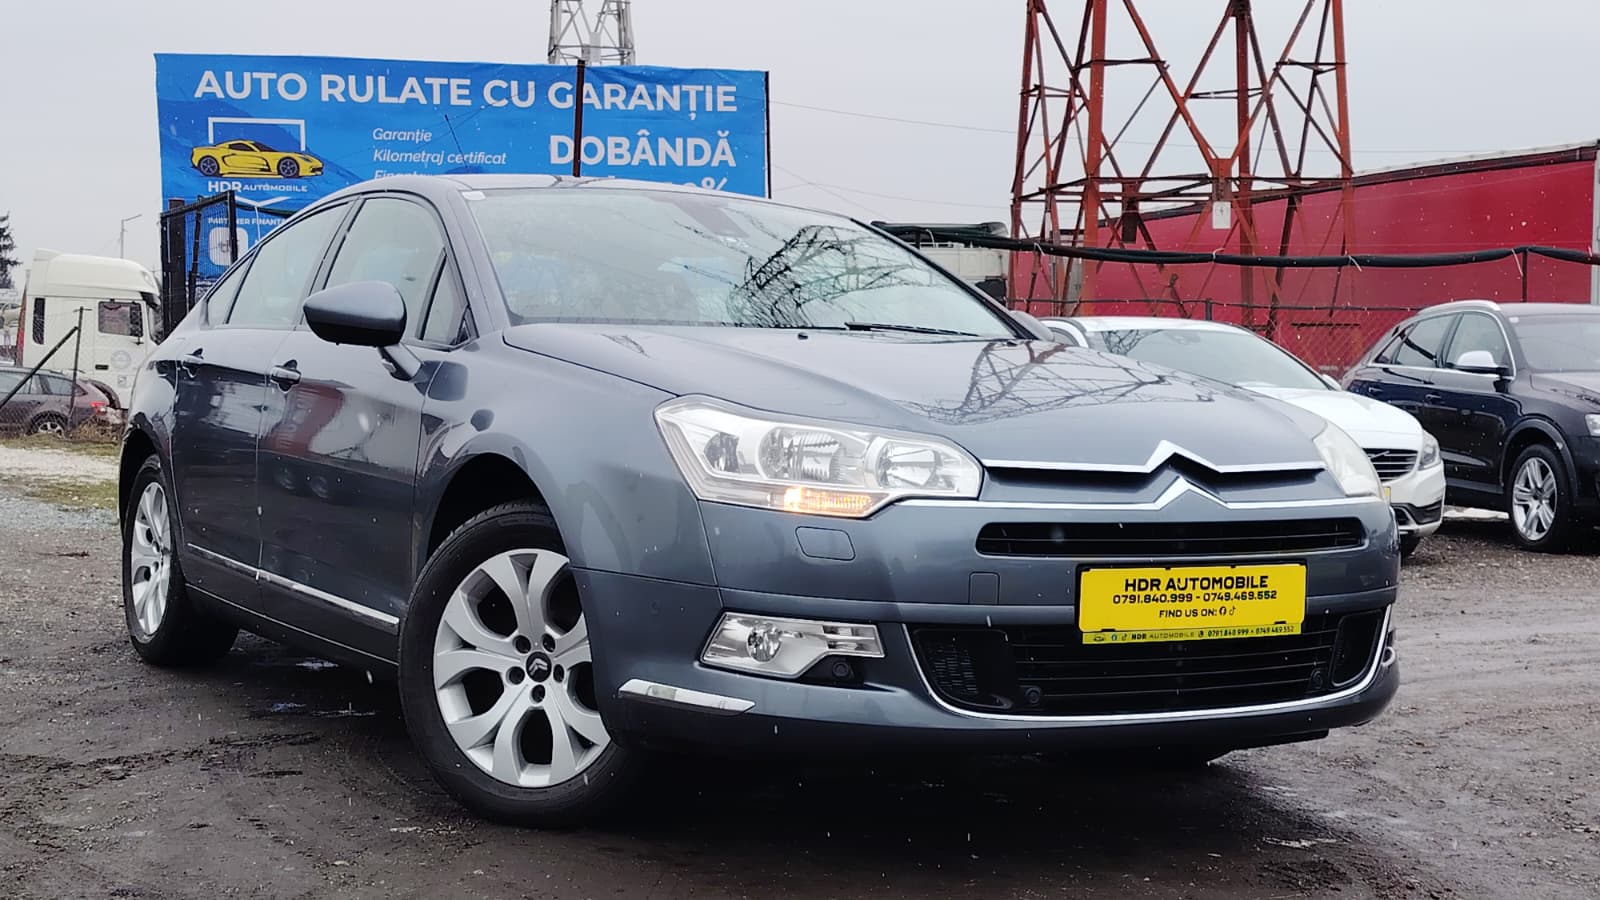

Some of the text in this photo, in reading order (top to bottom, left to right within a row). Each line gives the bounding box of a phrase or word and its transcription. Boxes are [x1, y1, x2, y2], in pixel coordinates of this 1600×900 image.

[194, 70, 737, 120] AUTO RULATE CU GARANȚIE
[550, 129, 736, 167] DOBÂNDĂ
[373, 149, 507, 165] Kilometraj certificat
[207, 181, 308, 193] HDR AUTOMOBILE
[1125, 575, 1269, 592] HDR AUTOMOBILE
[1112, 593, 1193, 605] 0791.840.999
[1203, 590, 1278, 601] 0749.469.552
[1159, 607, 1218, 618] FIND US ON:
